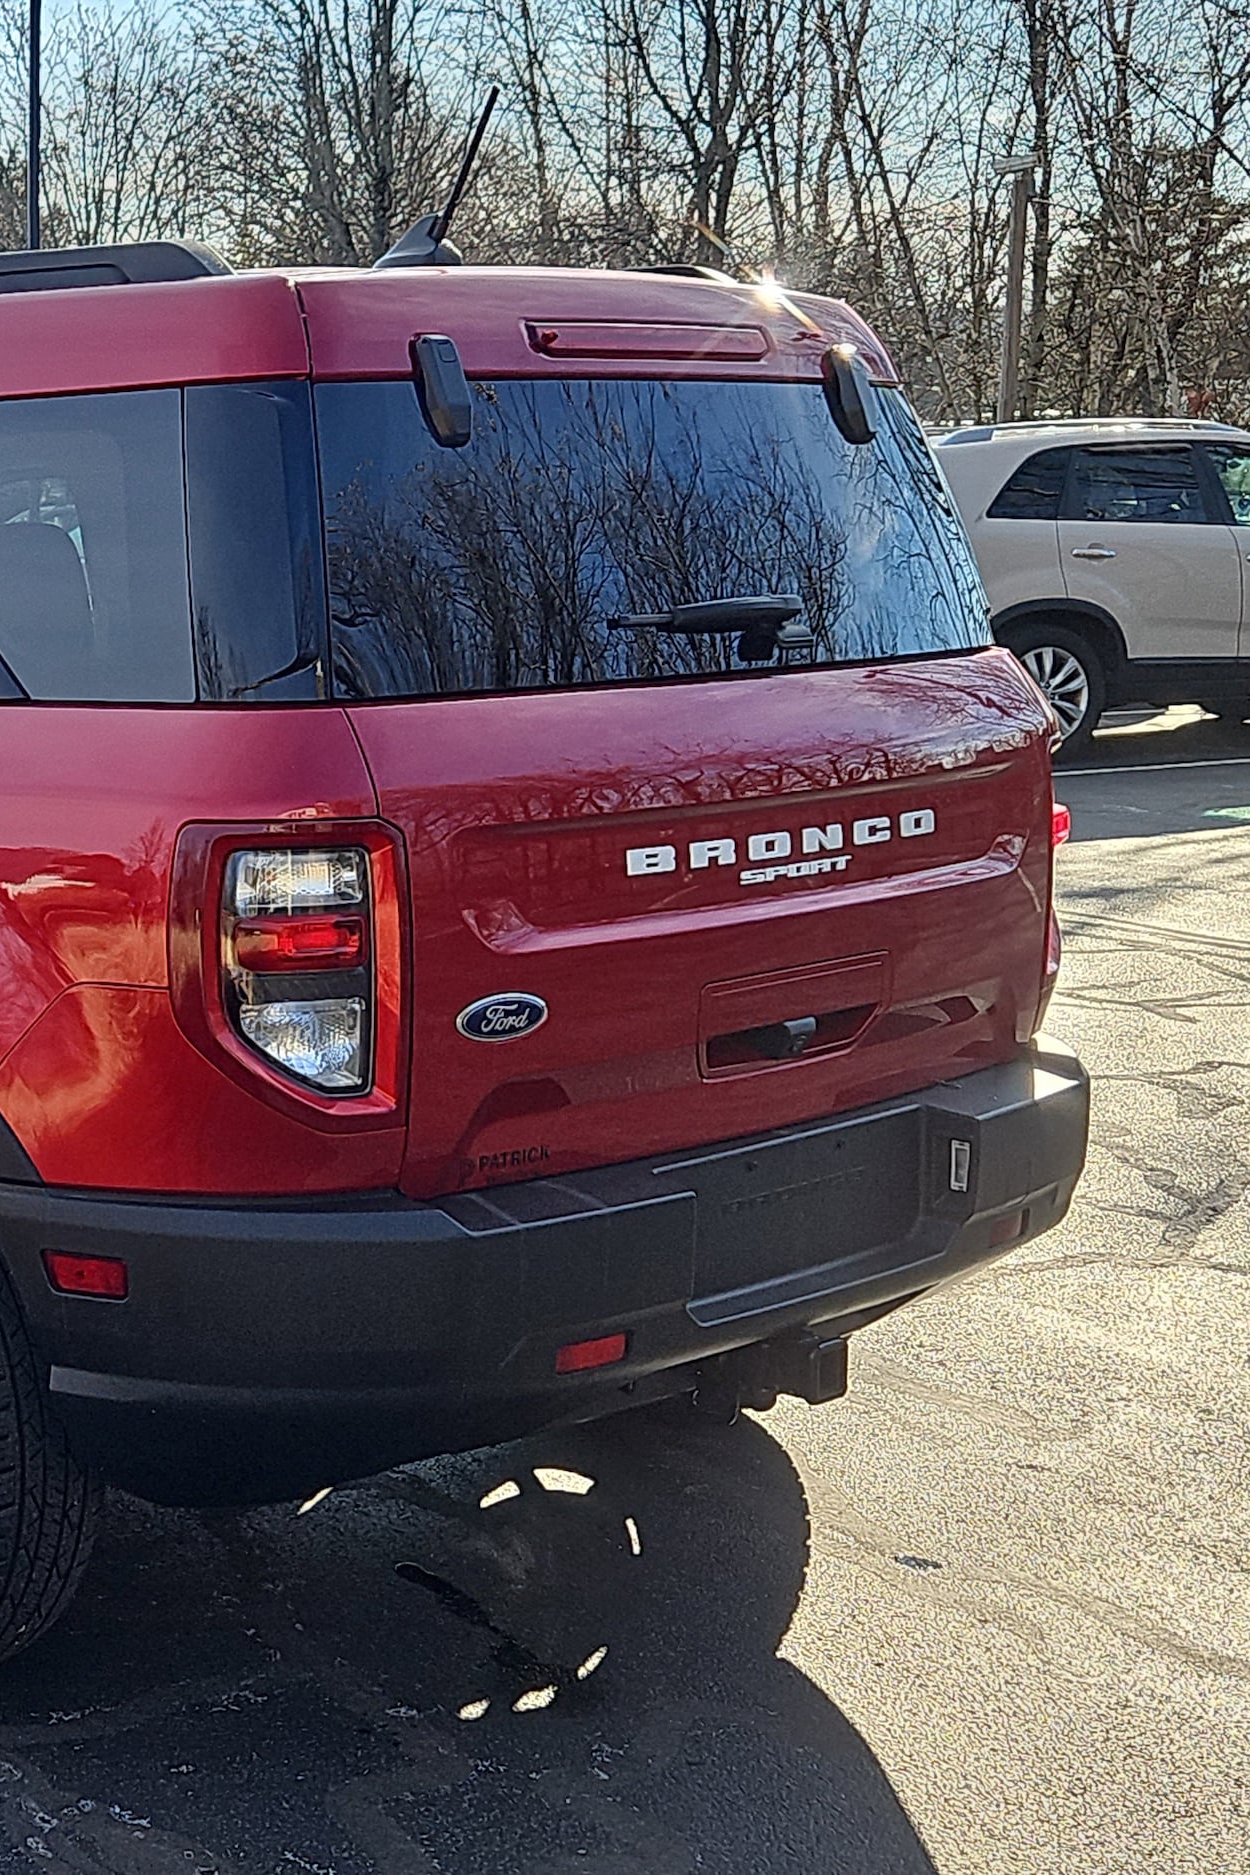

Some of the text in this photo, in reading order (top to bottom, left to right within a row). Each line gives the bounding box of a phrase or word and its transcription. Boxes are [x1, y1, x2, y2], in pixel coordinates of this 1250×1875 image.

[626, 808, 935, 877] BRONCO
[739, 855, 852, 885] SPORT
[481, 1003, 531, 1033] Ford
[478, 1144, 550, 1172] PATRICK
